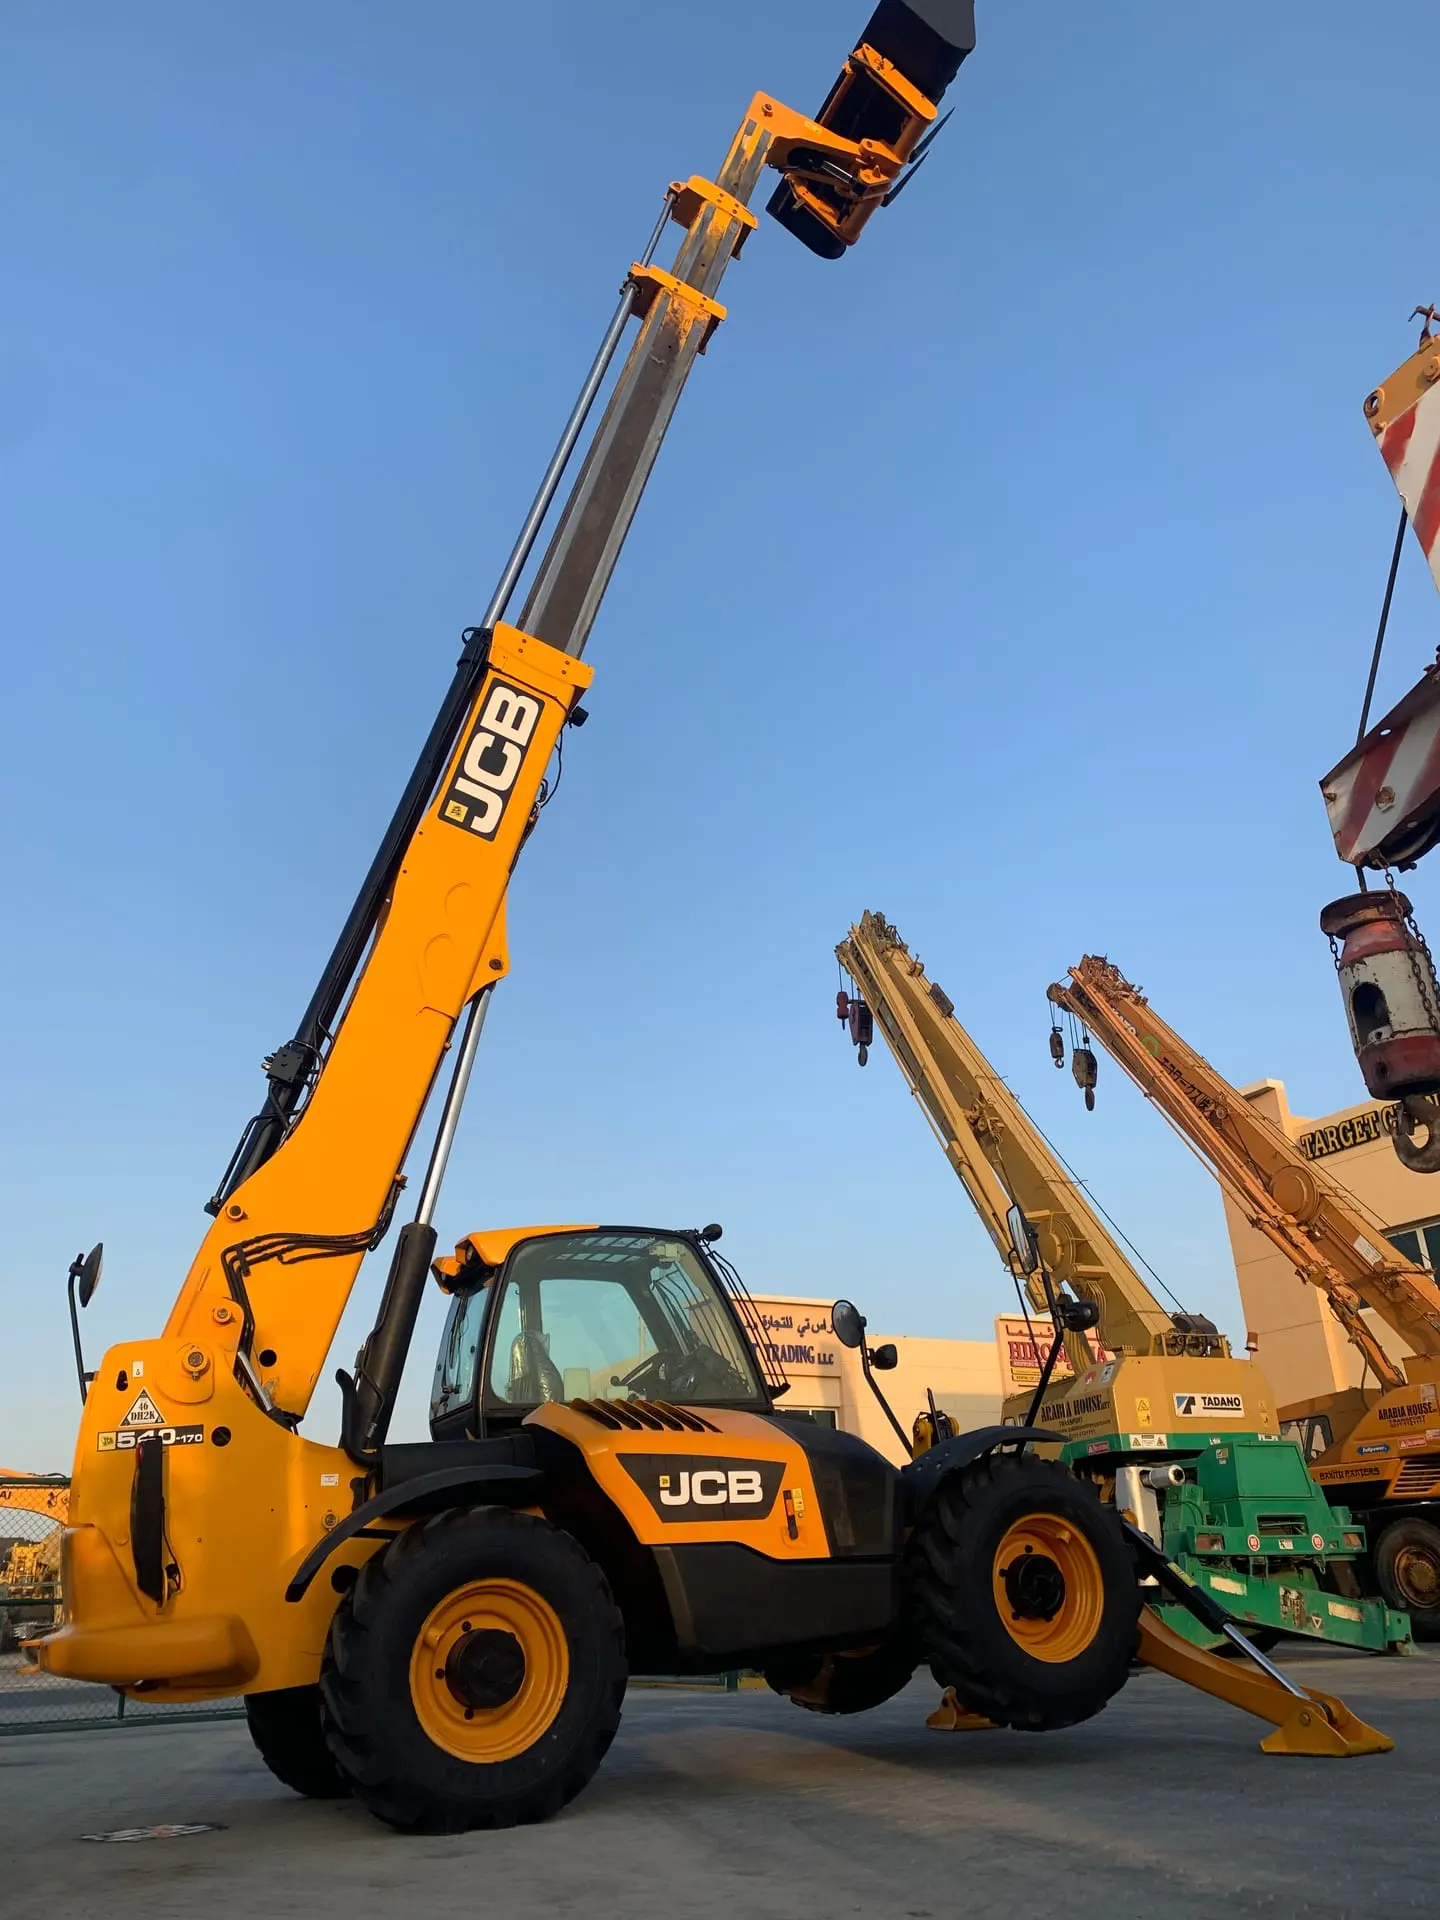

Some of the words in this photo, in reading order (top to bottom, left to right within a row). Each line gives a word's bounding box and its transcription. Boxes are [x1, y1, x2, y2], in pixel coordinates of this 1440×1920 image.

[455, 686, 539, 833] JCB
[1299, 1110, 1381, 1161] TARGET
[764, 1343, 815, 1364] TRADING
[817, 1353, 834, 1365] LLC
[138, 1401, 148, 1410] 46
[1041, 1402, 1072, 1422] ARABIA
[1073, 1394, 1102, 1415] HOUSE
[1201, 1396, 1241, 1407] TADANO
[1378, 1405, 1406, 1421] ARABIA
[1406, 1401, 1433, 1416] HOUSE
[130, 1411, 155, 1421] DH2K
[660, 1470, 763, 1506] JCB
